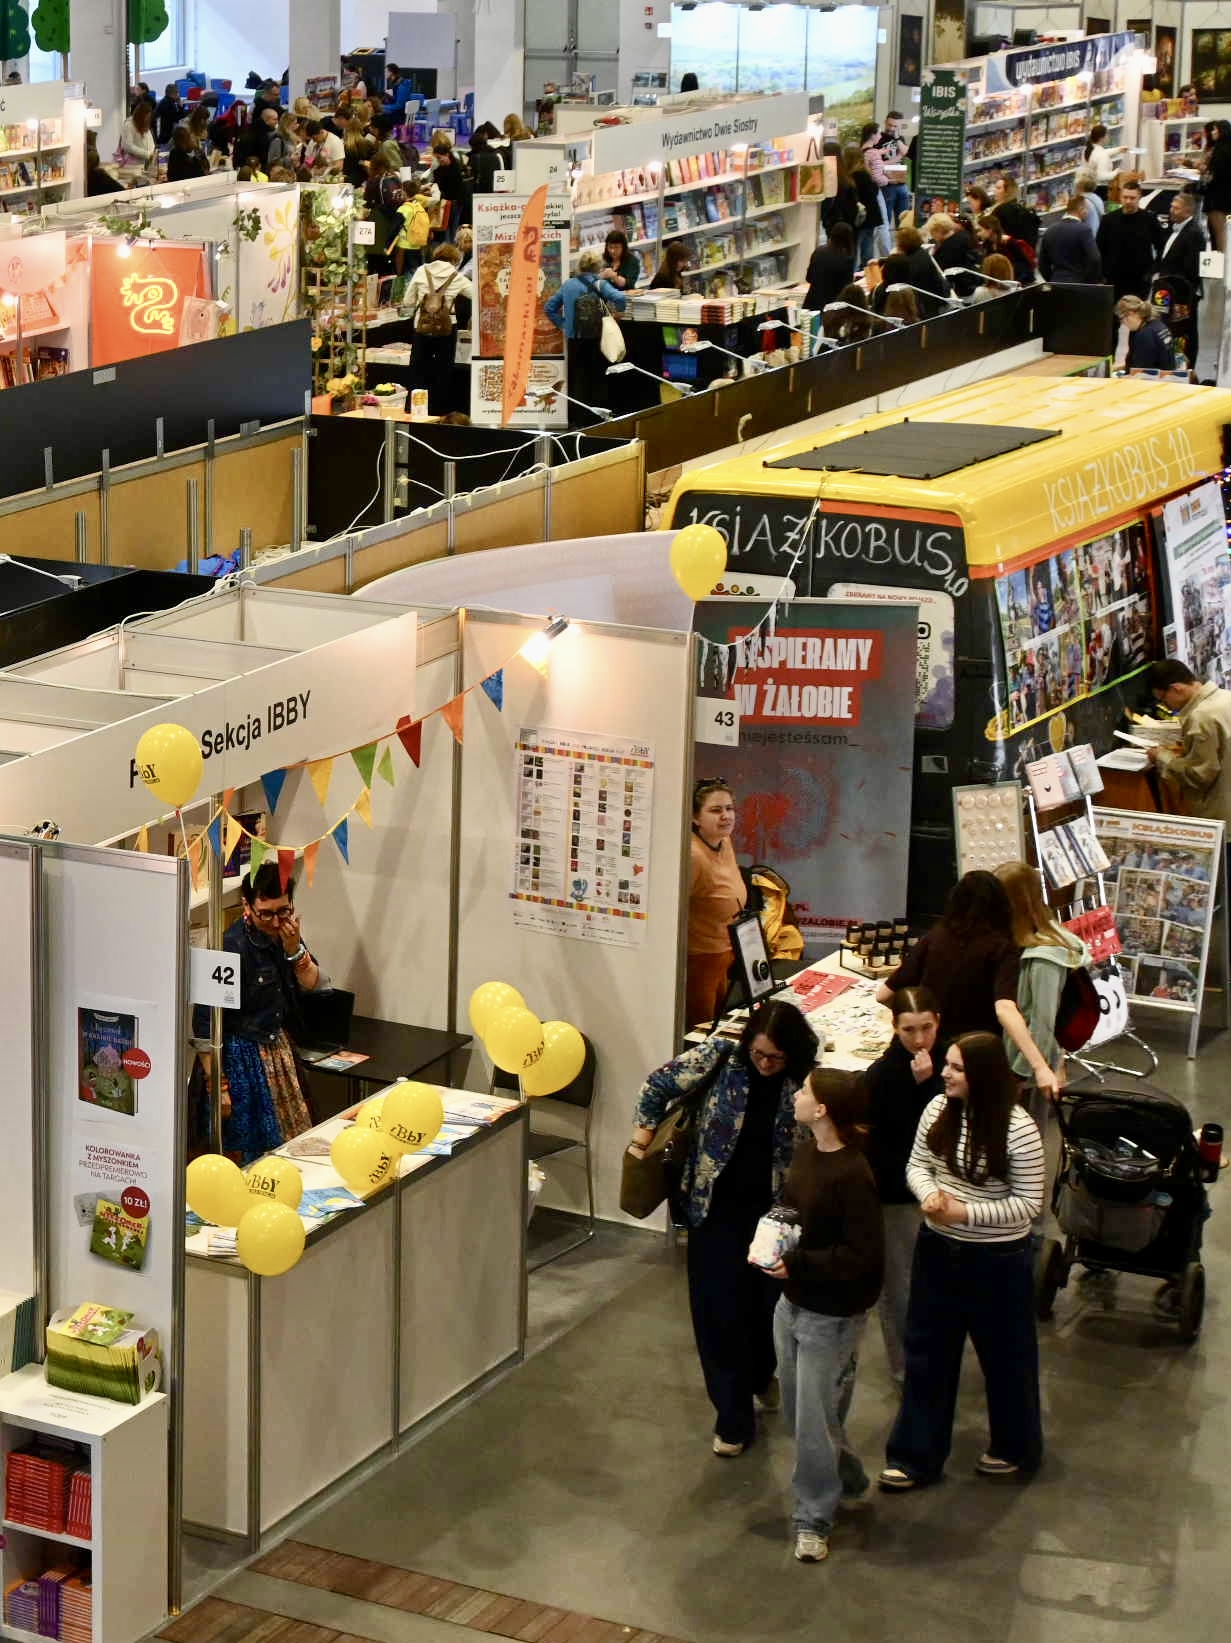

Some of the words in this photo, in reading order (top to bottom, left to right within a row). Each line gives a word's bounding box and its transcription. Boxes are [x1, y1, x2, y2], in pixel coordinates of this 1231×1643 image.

[931, 85, 957, 98] IBIS
[661, 127, 712, 150] Wydawnictwo
[714, 122, 732, 137] Dwie
[733, 116, 759, 133] Siostry
[496, 175, 506, 183] 25
[734, 683, 757, 716] W
[762, 677, 854, 719] ŻAŁOBIE
[200, 713, 262, 760] Sekcja
[267, 689, 311, 734] IBBY
[714, 711, 735, 727] 43
[211, 965, 235, 986] 42
[85, 1143, 141, 1161] KOLOROWANKA
[78, 1159, 148, 1180] PRZEDPREMIEROWO
[92, 1154, 139, 1169] MYSZONKIEM
[123, 1196, 133, 1206] 10
[135, 1198, 148, 1208] ZŁ!
